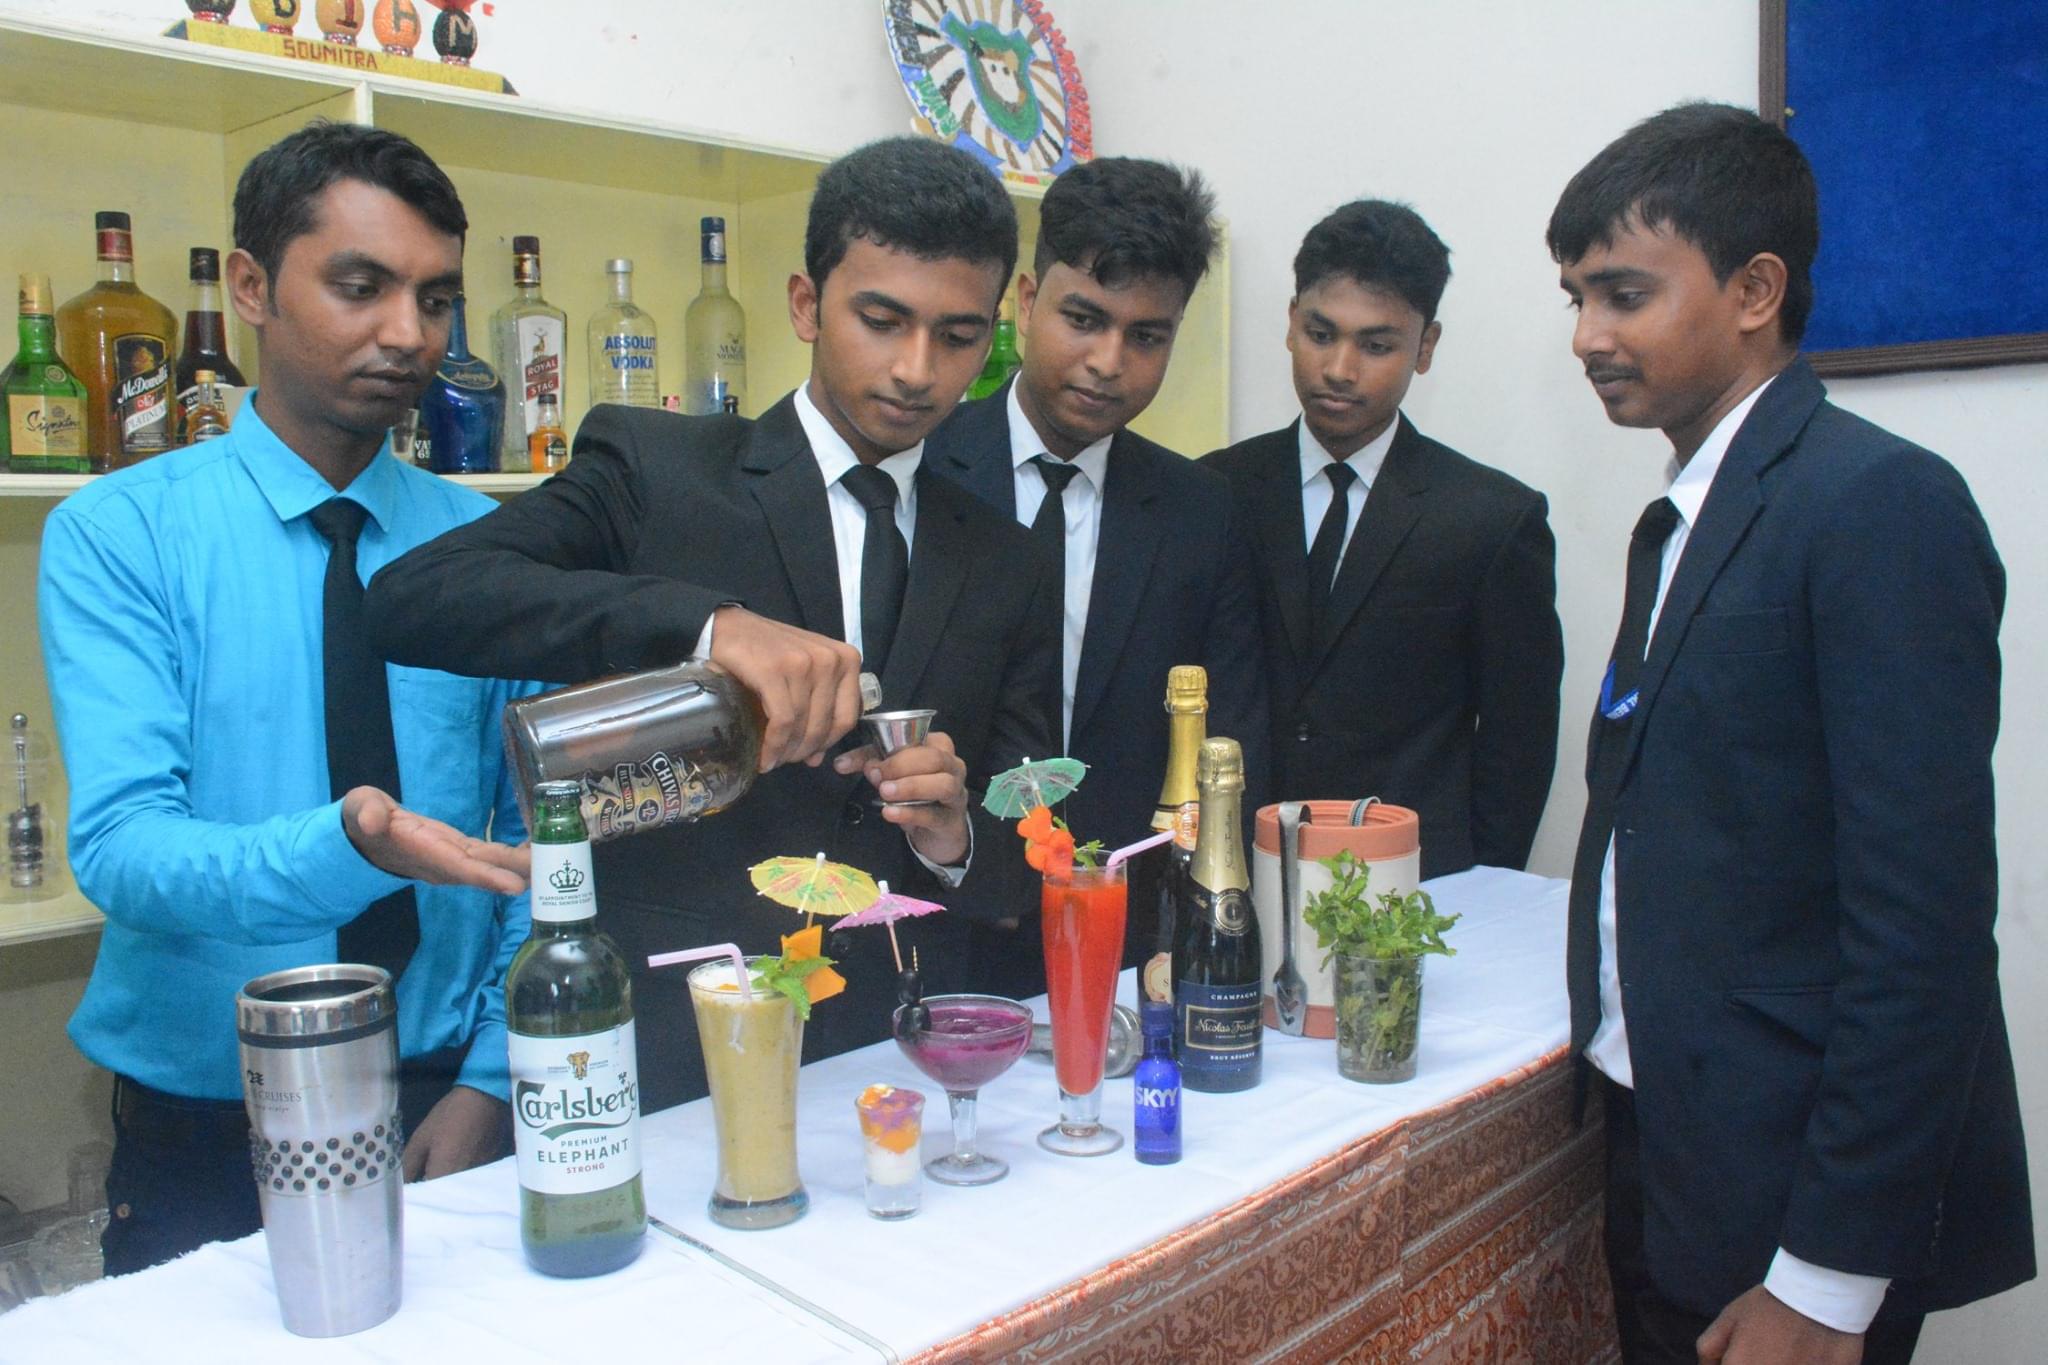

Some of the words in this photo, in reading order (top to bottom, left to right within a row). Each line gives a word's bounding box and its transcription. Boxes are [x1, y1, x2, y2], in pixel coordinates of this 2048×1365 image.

[283, 39, 377, 69] SOUMITRA
[605, 336, 656, 349] ABSOLUT
[527, 360, 556, 377] ROYAL
[611, 356, 653, 369] VODKA
[531, 382, 554, 396] STAG
[619, 769, 633, 811] BLENDED
[652, 757, 679, 809] CHIVAS
[1196, 1018, 1231, 1033] Nicolas
[258, 1090, 302, 1103] CRUISES
[516, 1078, 637, 1129] Carlsberg
[1136, 1087, 1179, 1109] SKYY
[561, 1135, 607, 1147] PREMIUM
[537, 1138, 629, 1163] ELEPHANT
[566, 1163, 605, 1174] STRONG
